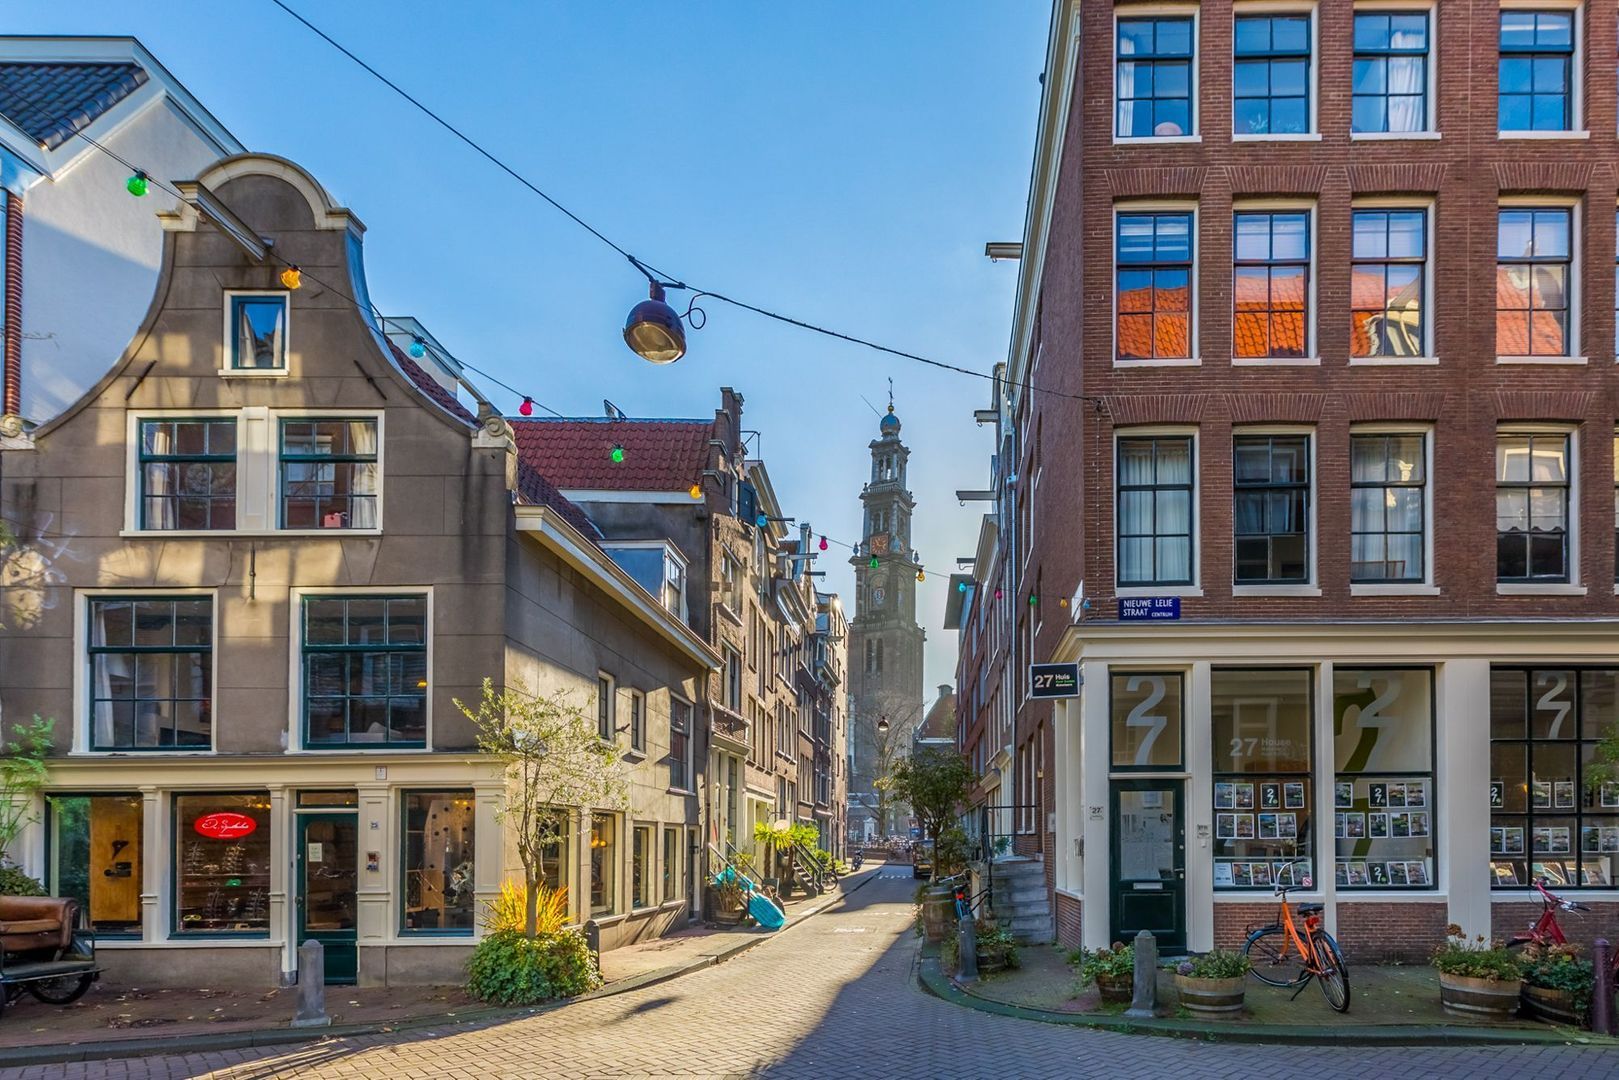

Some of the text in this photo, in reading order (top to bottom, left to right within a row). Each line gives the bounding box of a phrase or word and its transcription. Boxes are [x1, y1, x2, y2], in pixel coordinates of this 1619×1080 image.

[1123, 599, 1173, 608] NIEUWE LELIE
[1123, 608, 1148, 617] STRAAT
[1034, 673, 1070, 688] 27 Huis
[1230, 736, 1291, 757] 27 House
